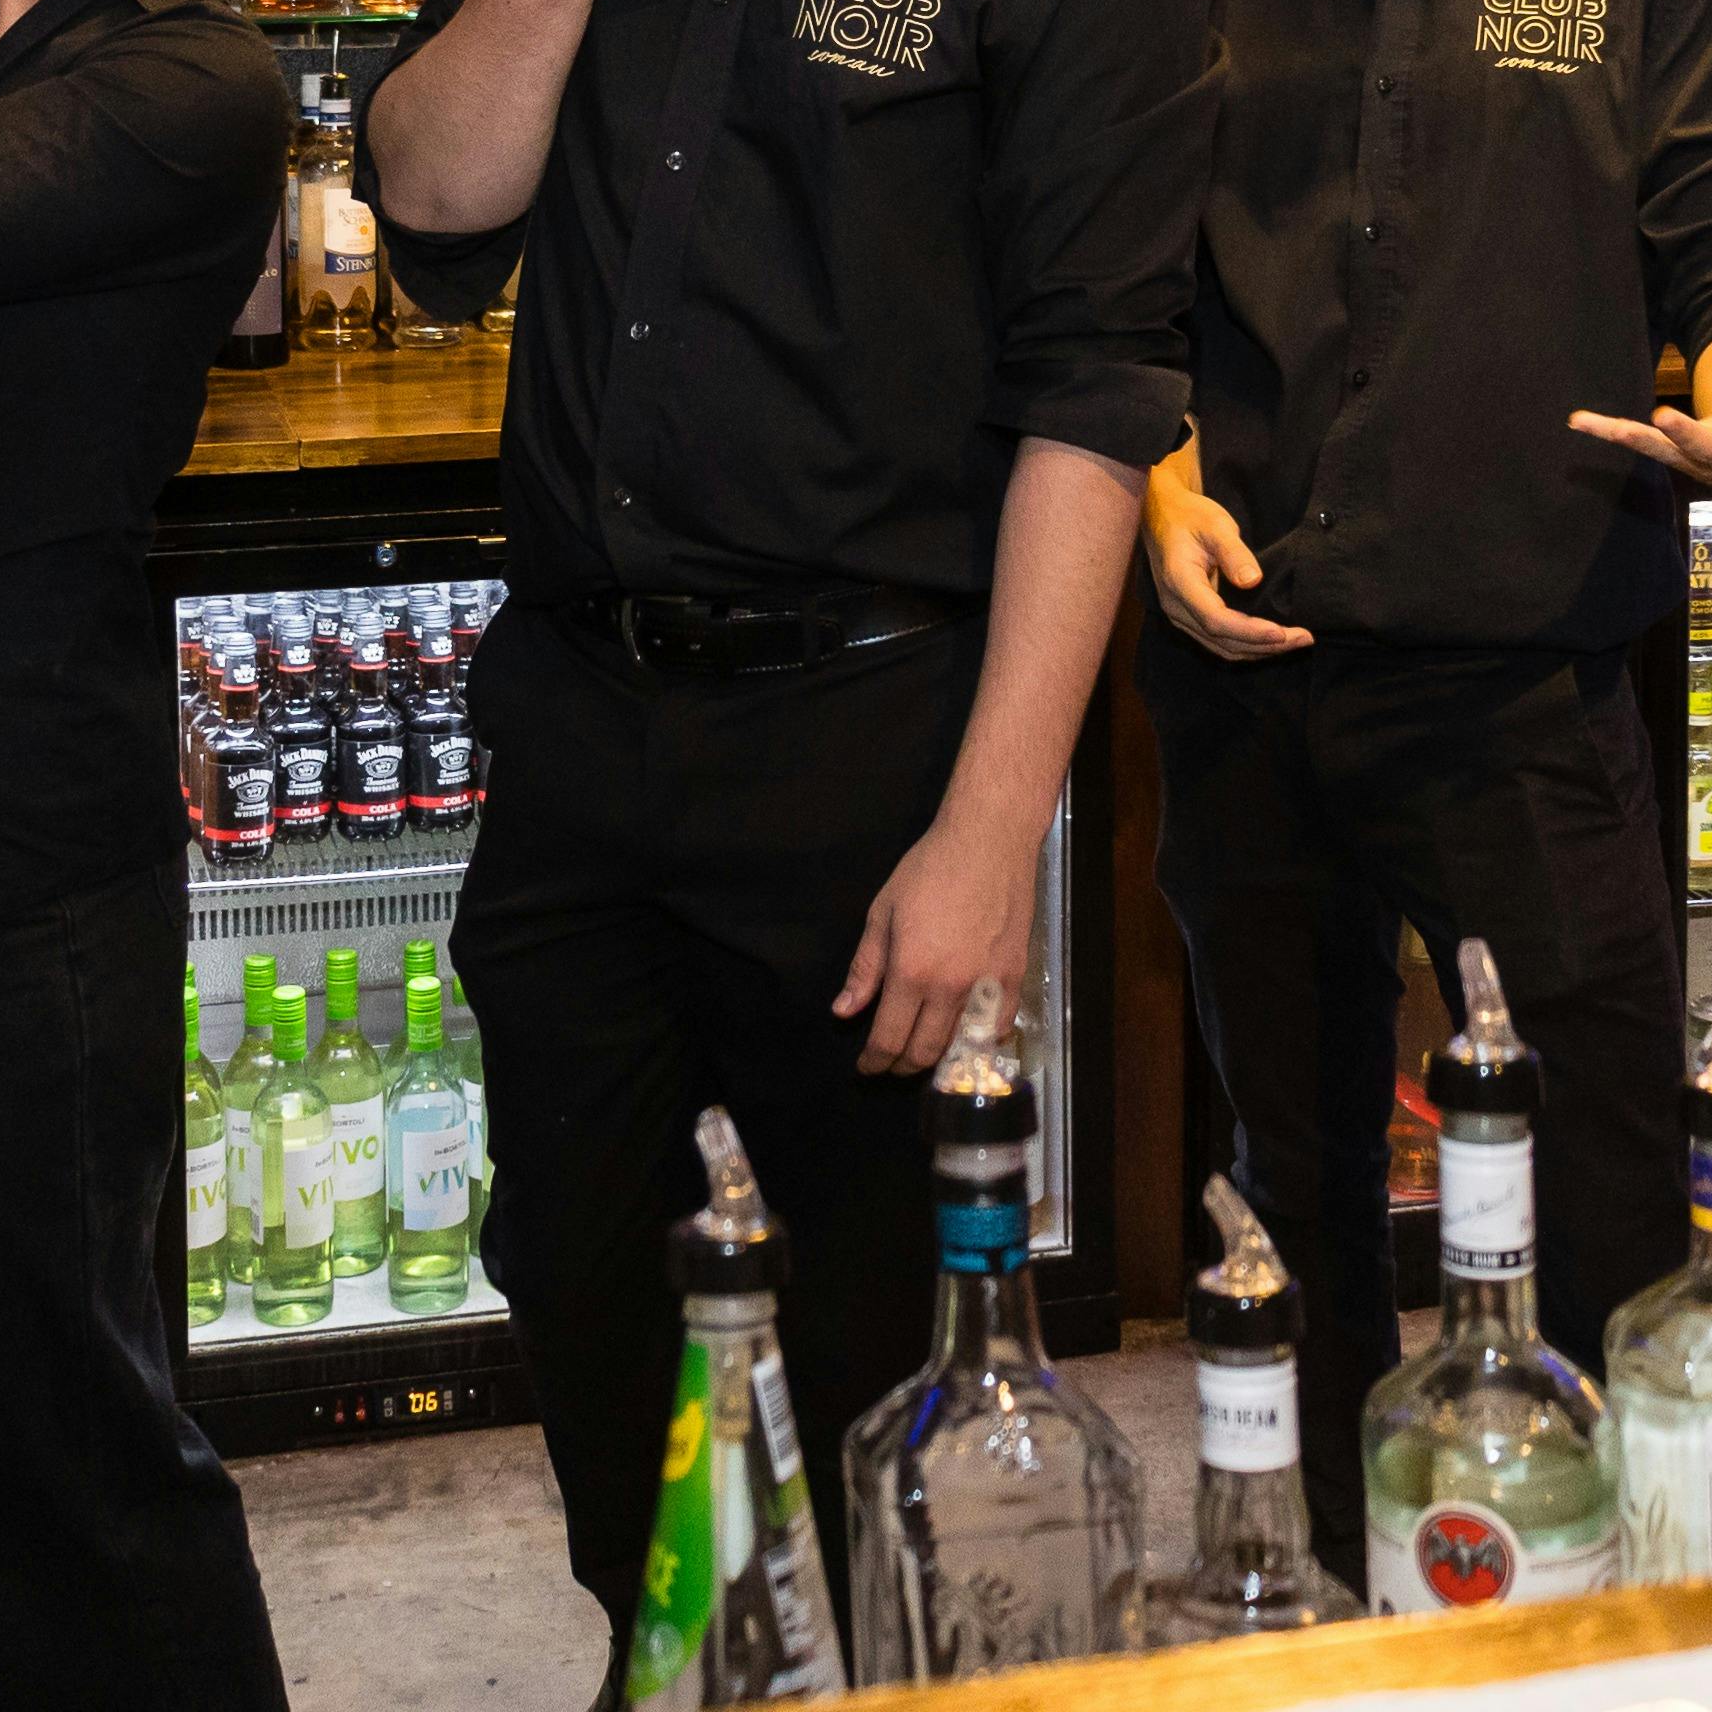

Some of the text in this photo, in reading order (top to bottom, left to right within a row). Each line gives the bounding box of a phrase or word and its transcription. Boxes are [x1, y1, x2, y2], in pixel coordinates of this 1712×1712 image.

[1475, 14, 1605, 65] NOIR
[280, 751, 301, 768] JACK
[443, 794, 469, 806] COLA
[291, 806, 321, 817] COLA
[369, 803, 397, 815] COLA
[239, 828, 267, 840] COLA
[418, 1163, 468, 1196] VIV
